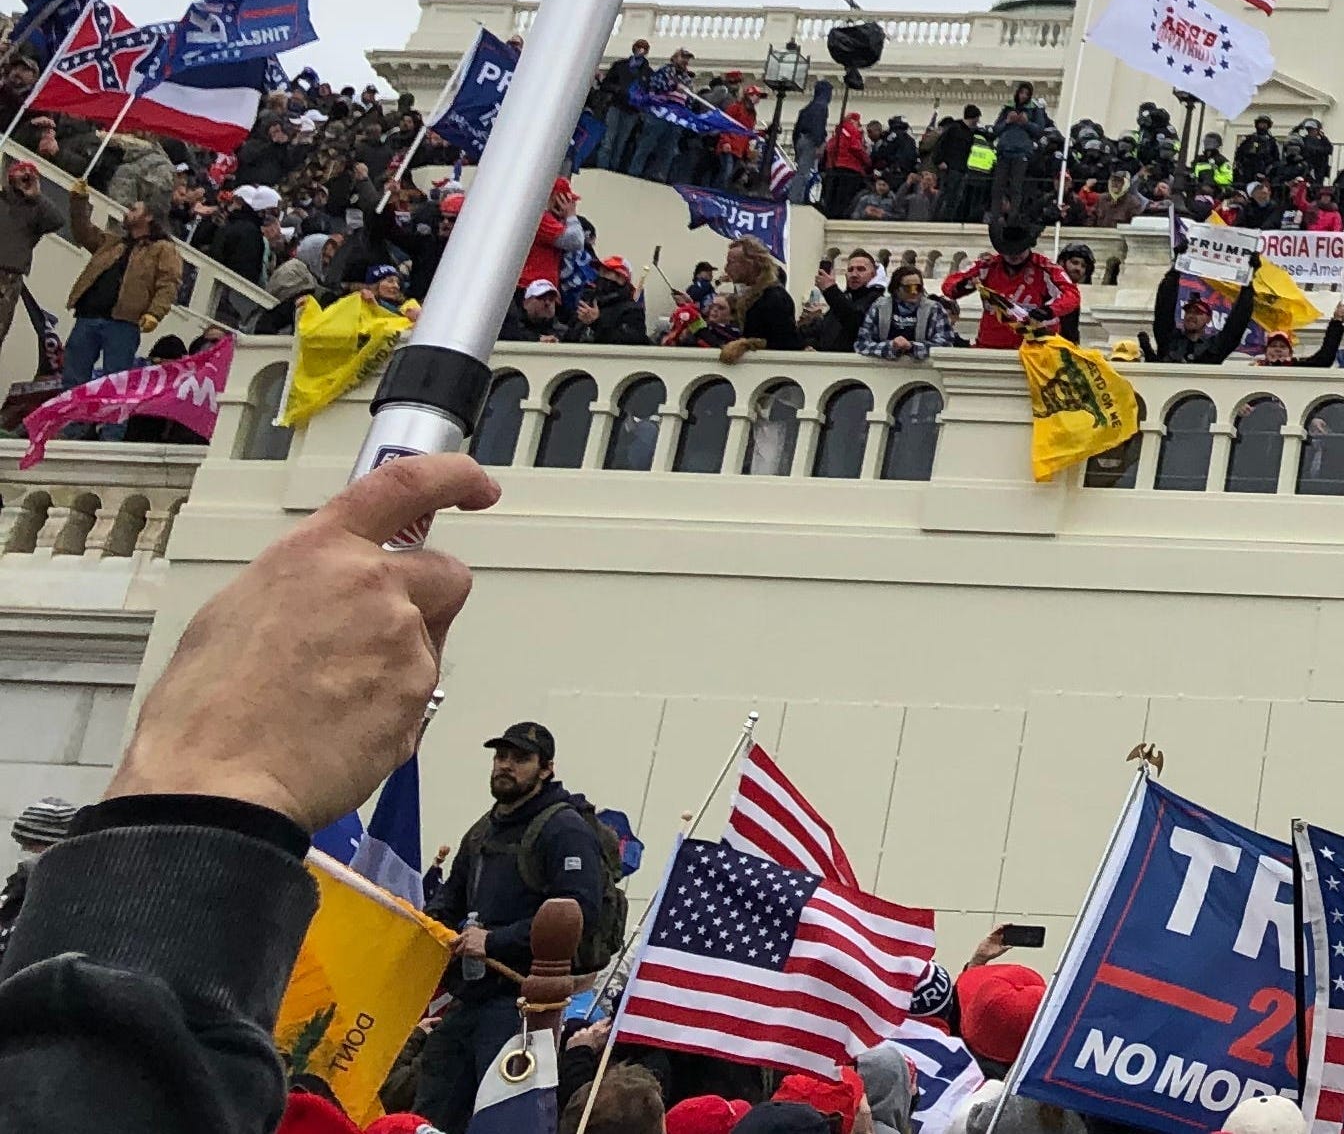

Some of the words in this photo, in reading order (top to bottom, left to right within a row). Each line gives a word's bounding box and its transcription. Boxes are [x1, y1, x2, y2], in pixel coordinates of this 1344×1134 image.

[1188, 236, 1254, 258] TRUMP
[1189, 247, 1244, 264] PENCE
[1165, 825, 1309, 976] TR
[1074, 1028, 1157, 1086] NO
